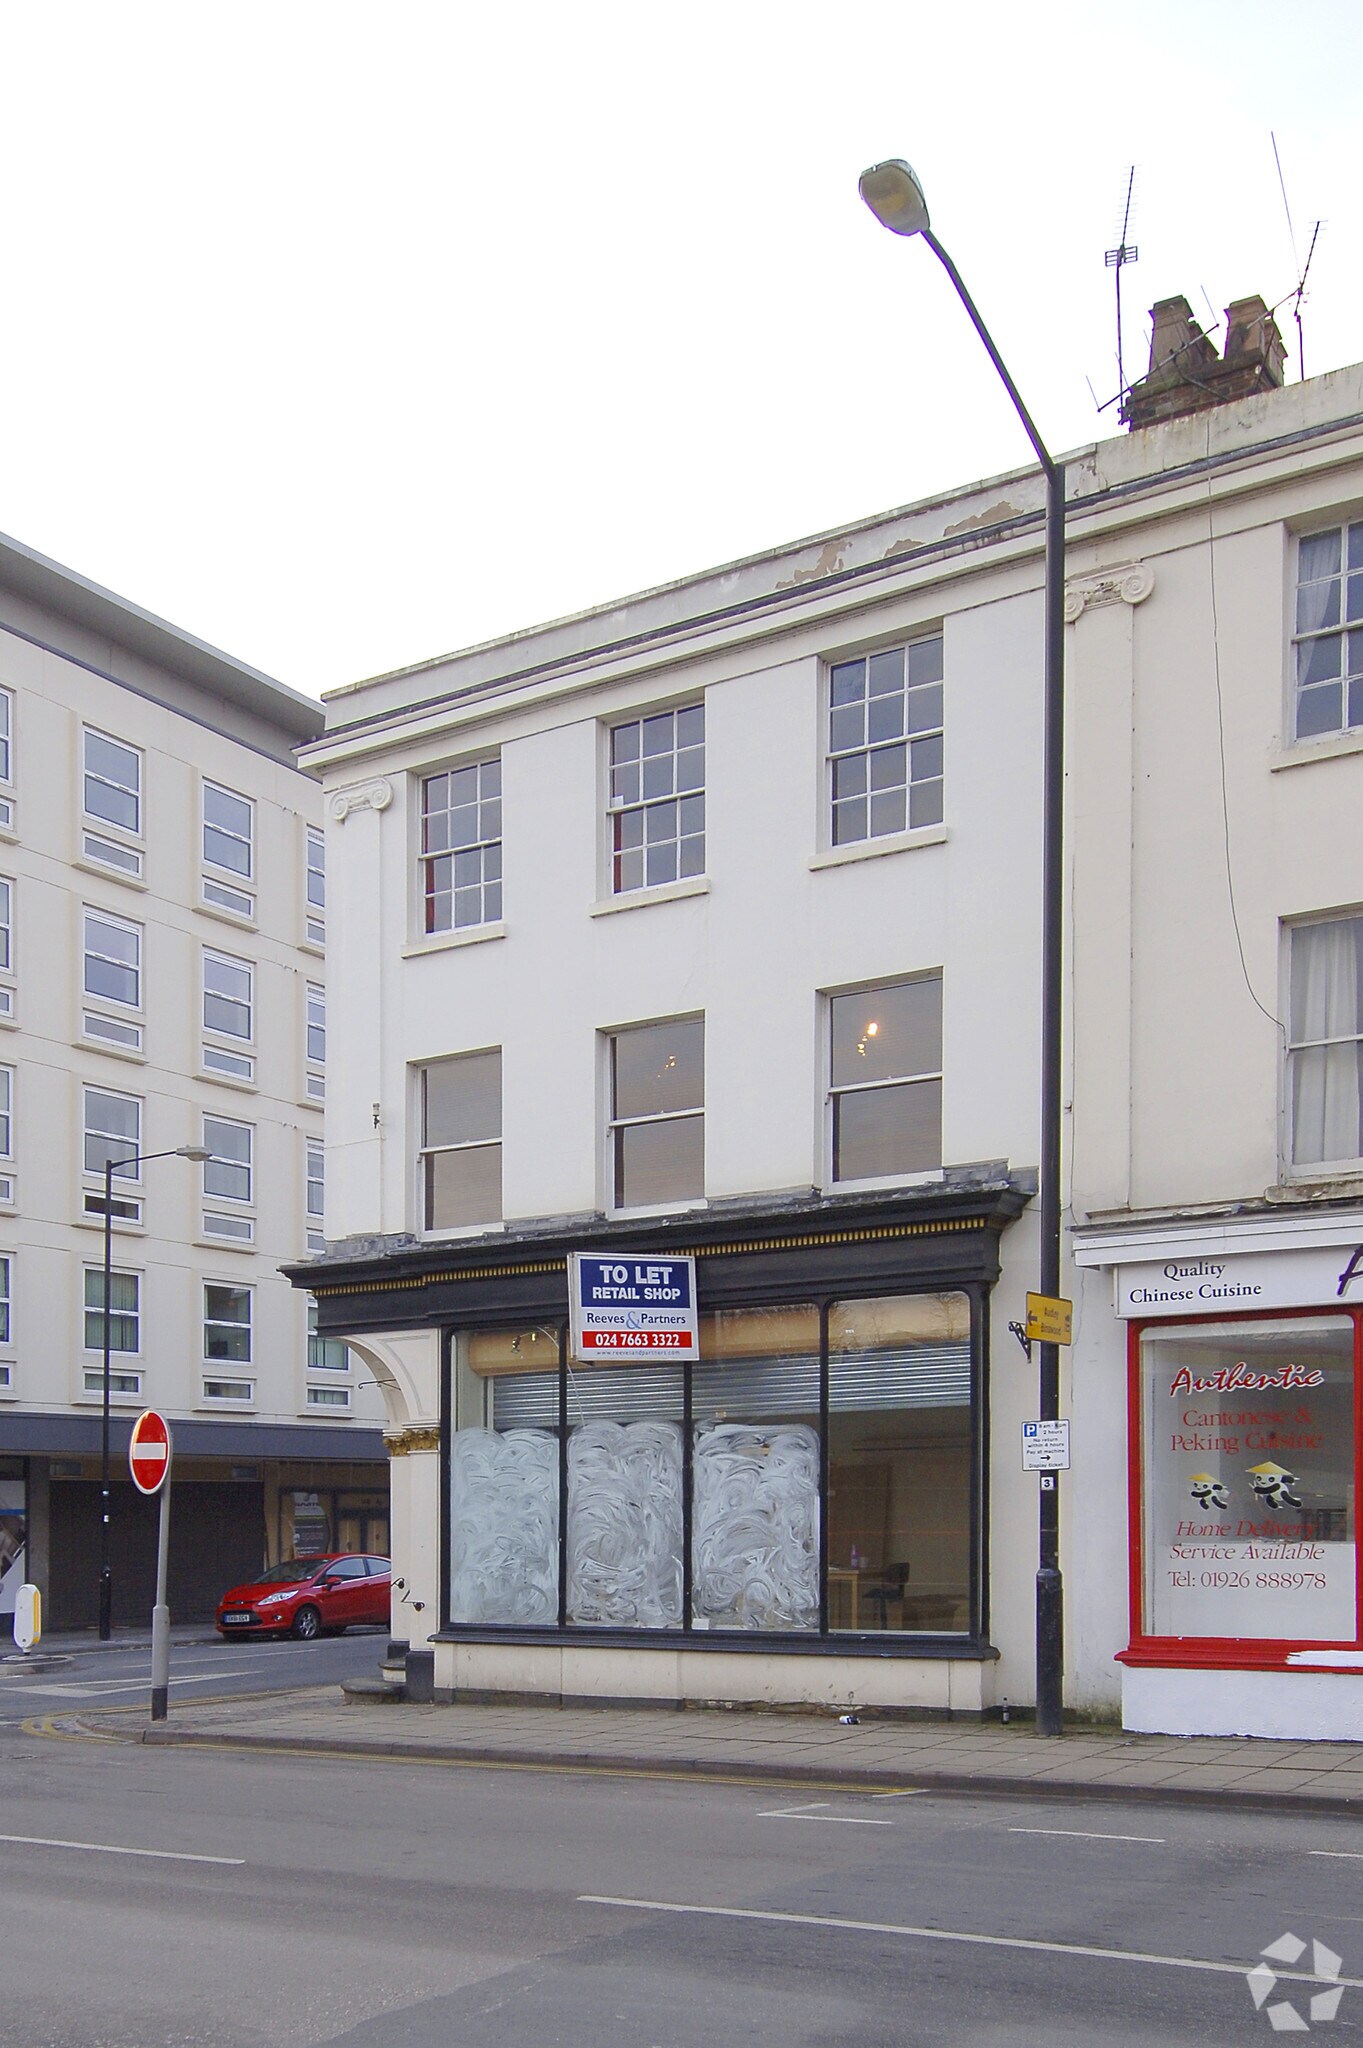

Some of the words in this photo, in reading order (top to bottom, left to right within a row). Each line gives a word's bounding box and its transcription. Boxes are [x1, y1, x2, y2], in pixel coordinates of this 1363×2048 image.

[599, 1265, 628, 1284] TO
[635, 1266, 672, 1285] LET
[1163, 1261, 1226, 1281] Quality
[592, 1286, 640, 1299] RETAIL
[643, 1287, 681, 1300] SHOP
[1129, 1288, 1193, 1304] Chinese
[1198, 1282, 1262, 1300] Cuisine
[586, 1312, 625, 1324] Reeves
[626, 1310, 642, 1330] &
[641, 1313, 686, 1324] Partners
[595, 1333, 617, 1346] 024
[620, 1333, 649, 1346] 7663
[652, 1333, 680, 1346] 3322
[1170, 1361, 1325, 1398] Authentic
[1182, 1409, 1290, 1427] Cantonese
[1294, 1405, 1312, 1425] &
[1026, 1424, 1036, 1437] P
[1171, 1433, 1240, 1456] Peking
[1044, 1479, 1051, 1488] 3
[1176, 1520, 1231, 1537] Home
[1236, 1517, 1320, 1540] Delivery
[1169, 1543, 1236, 1560] Service
[1241, 1542, 1325, 1560] Available
[1168, 1571, 1196, 1587] Tel:
[1200, 1570, 1250, 1589] 01926
[1255, 1572, 1326, 1590] 888978
